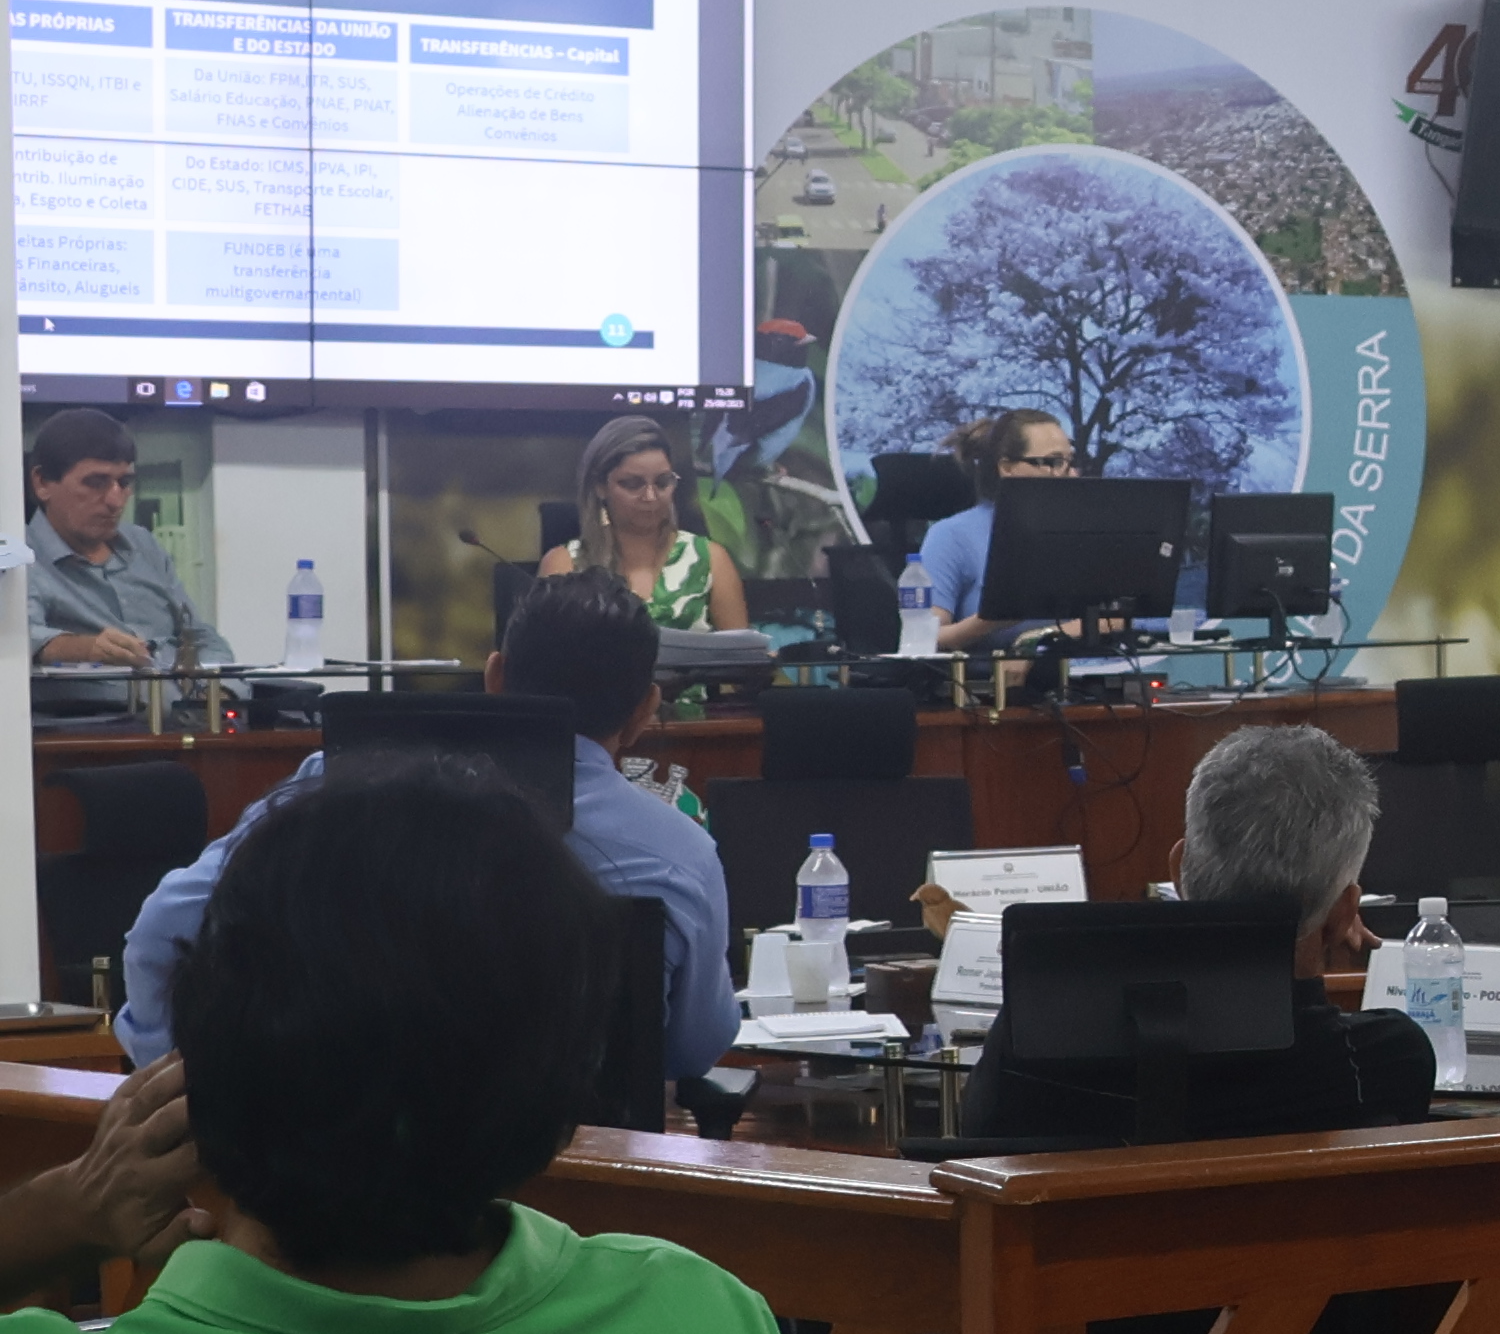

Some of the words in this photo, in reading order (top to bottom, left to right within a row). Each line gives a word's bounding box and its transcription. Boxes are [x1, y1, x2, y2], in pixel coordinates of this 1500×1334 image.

[29, 11, 115, 33] PRÓPRIAS
[172, 10, 312, 34] TRANSFERÊNCIAS
[316, 21, 338, 37] DA
[341, 20, 392, 40] UNIÃO
[233, 37, 244, 52] E
[246, 38, 271, 54] DO
[274, 39, 336, 56] ESTADO
[420, 37, 553, 60] TRANSFERÊNCIAS
[567, 46, 621, 67] Capital
[99, 75, 129, 91] ITBI
[99, 149, 119, 165] de
[30, 193, 83, 212] Esgoto
[99, 195, 148, 211] Coleta
[17, 278, 71, 295] ânsito,
[607, 323, 627, 337] 11
[1349, 330, 1392, 492] SERRA
[1331, 504, 1377, 565] DA
